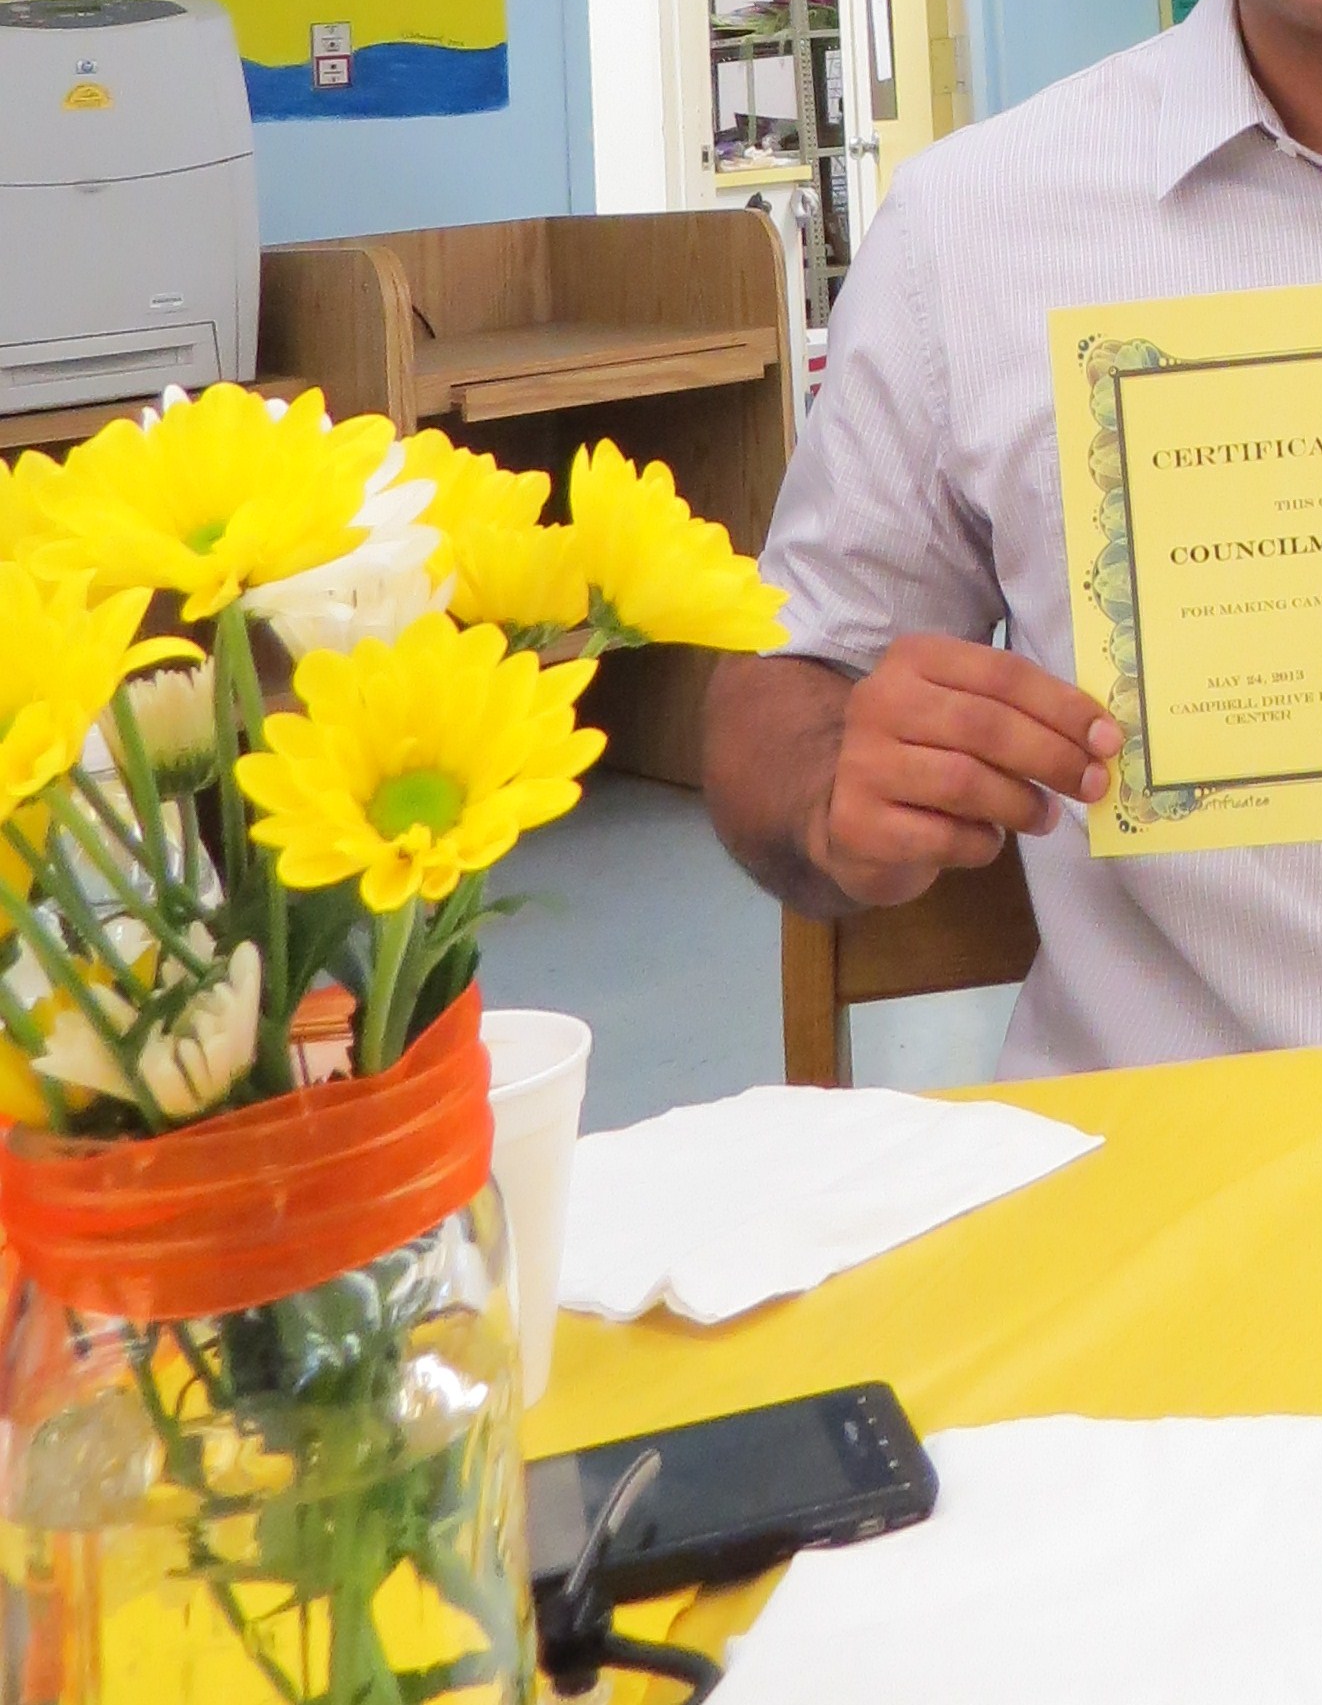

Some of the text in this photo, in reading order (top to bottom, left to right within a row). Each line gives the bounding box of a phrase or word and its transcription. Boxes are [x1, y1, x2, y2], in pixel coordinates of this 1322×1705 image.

[1274, 498, 1315, 512] THIS
[1180, 605, 1215, 619] FOR
[1219, 599, 1288, 616] MAKING
[1207, 675, 1241, 689] MAY
[1271, 669, 1305, 684] 2013
[1169, 699, 1258, 715] CAMPBELL
[1261, 691, 1314, 708] DRIVE
[1225, 710, 1291, 726] CENTER
